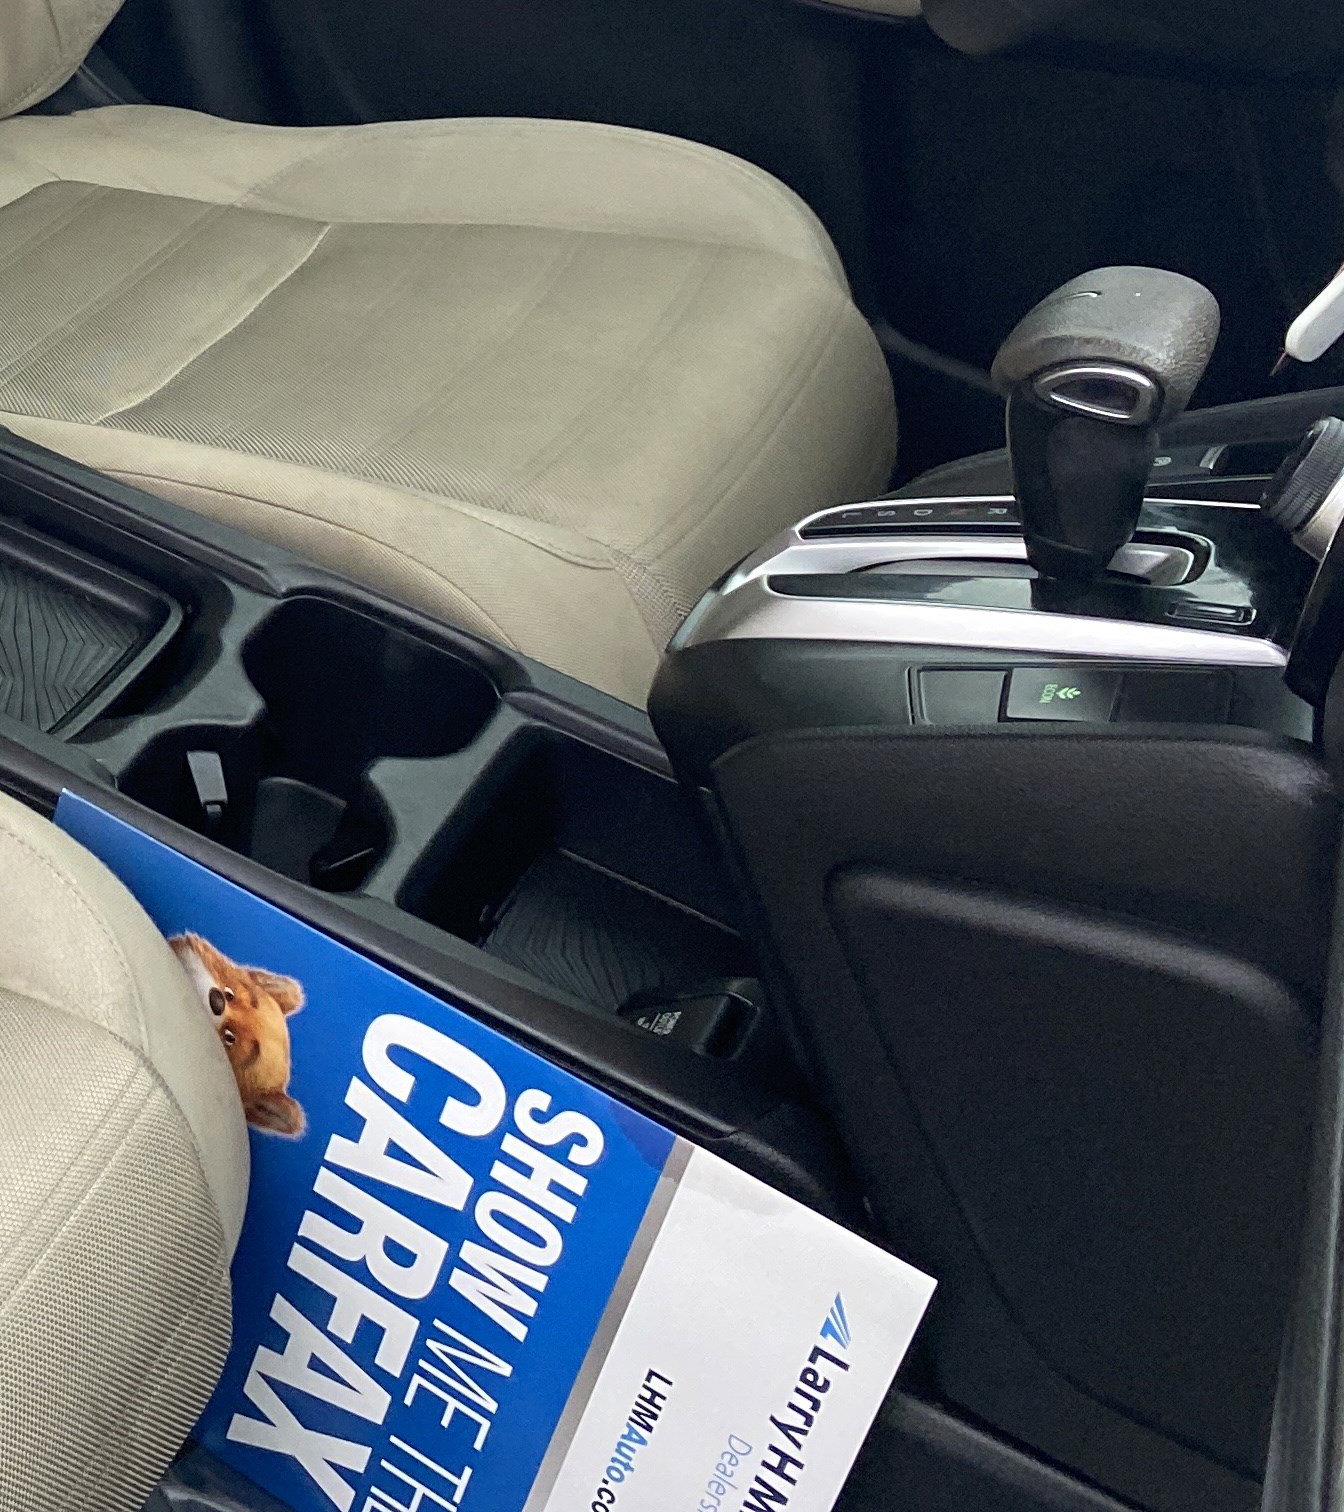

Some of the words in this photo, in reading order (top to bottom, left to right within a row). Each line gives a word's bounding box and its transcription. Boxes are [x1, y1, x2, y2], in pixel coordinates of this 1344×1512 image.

[225, 1013, 507, 1512] CARFAX
[448, 1087, 605, 1343] SHOW
[403, 1318, 514, 1452] ME
[361, 1434, 473, 1512] TH
[697, 1433, 753, 1512] Dealers
